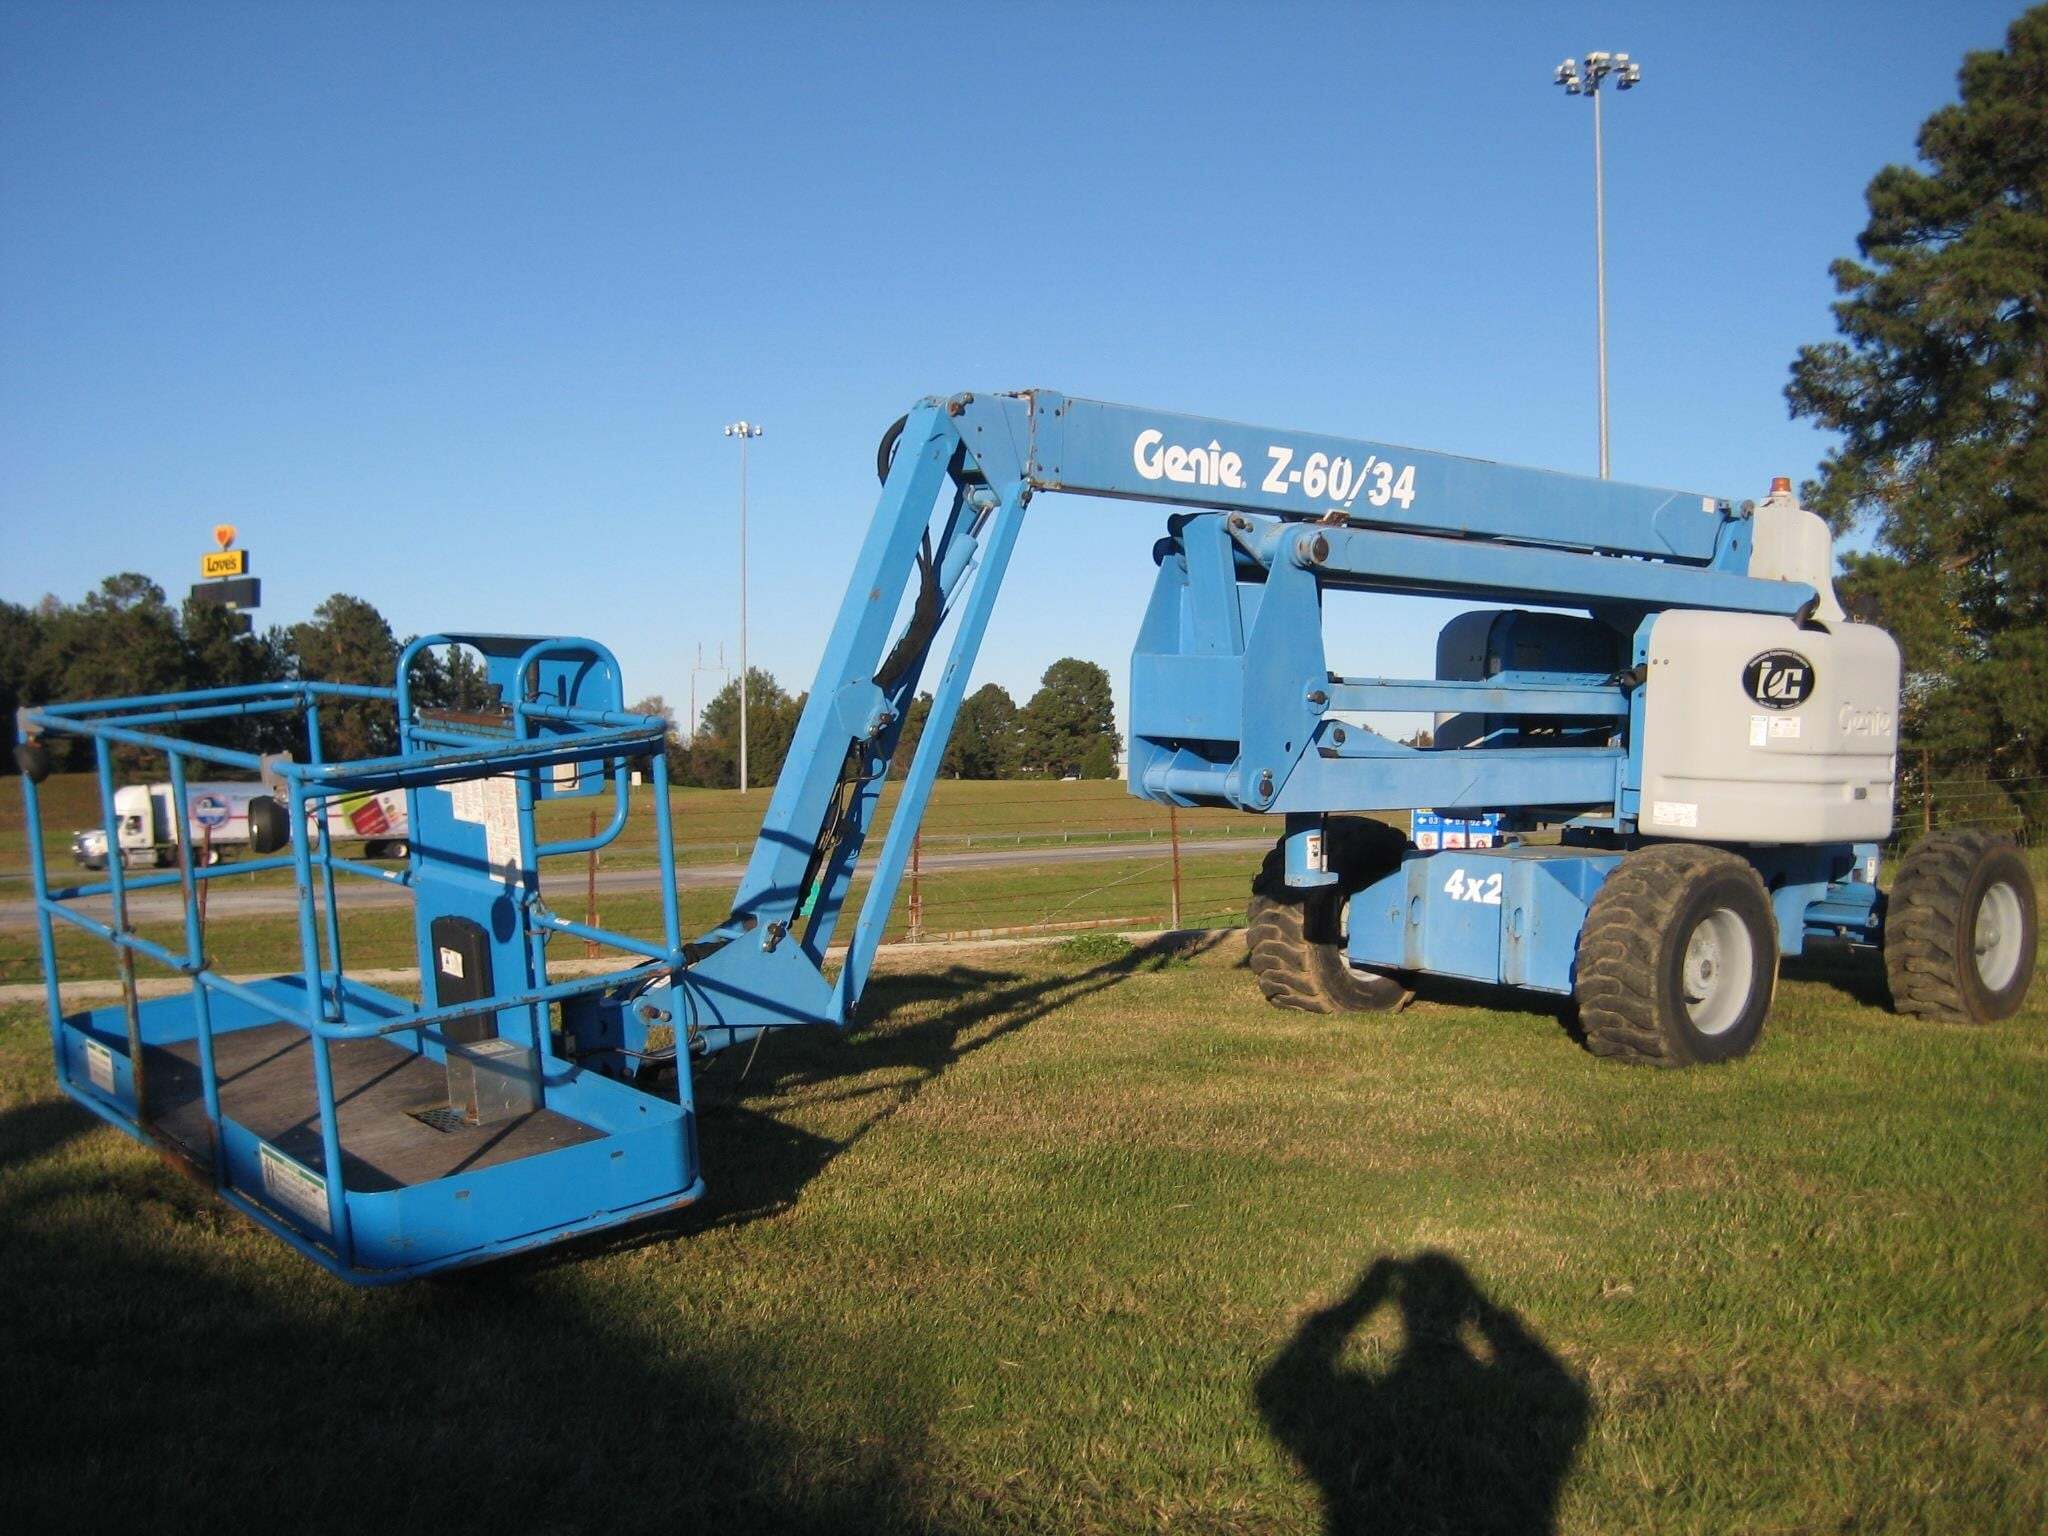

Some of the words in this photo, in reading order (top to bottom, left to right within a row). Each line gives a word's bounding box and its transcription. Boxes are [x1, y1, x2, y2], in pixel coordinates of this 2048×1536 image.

[1134, 429, 1246, 489] Genie
[1262, 446, 1416, 509] Z-60/34
[206, 556, 237, 572] Love's
[1839, 701, 1891, 737] Genie
[1444, 869, 1502, 905] 4x2
